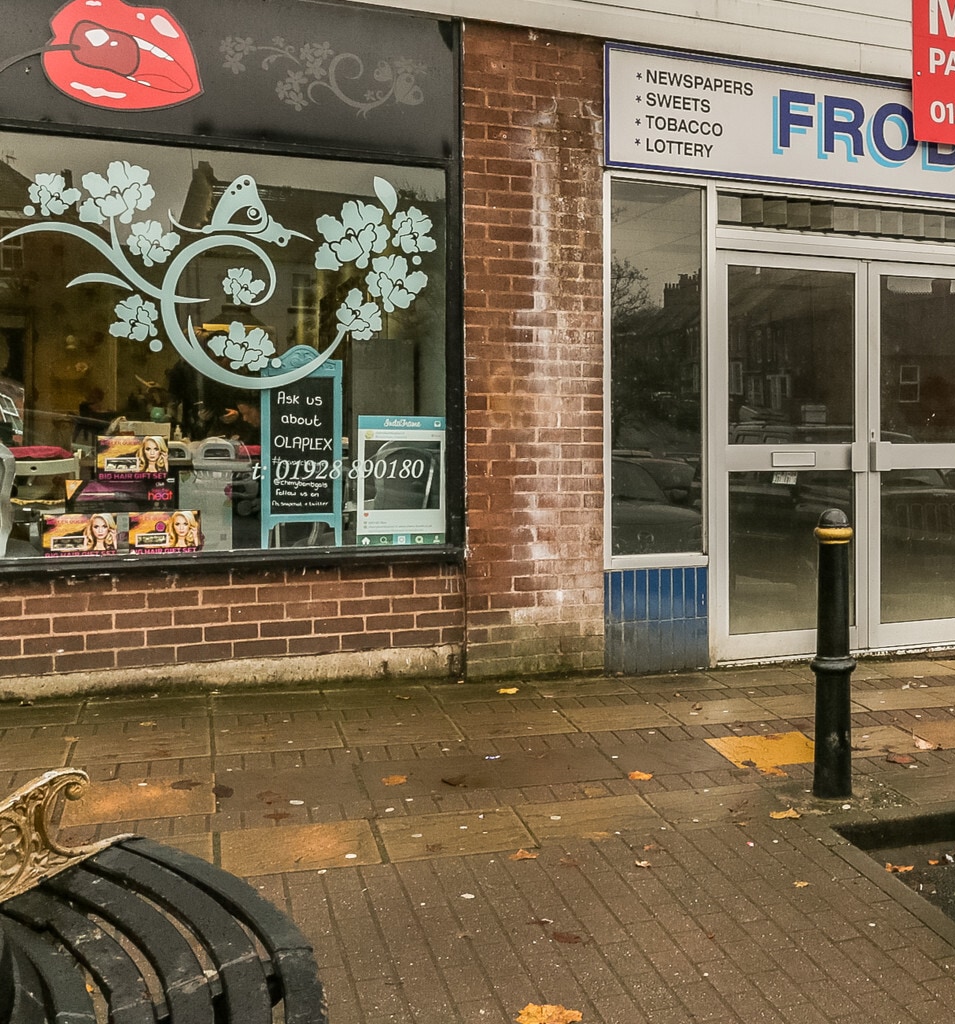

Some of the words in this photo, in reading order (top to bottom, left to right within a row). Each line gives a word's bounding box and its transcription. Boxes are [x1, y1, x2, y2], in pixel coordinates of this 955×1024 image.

[646, 69, 753, 96] NEWSPAPERS
[646, 92, 711, 113] SWEETS
[645, 114, 723, 137] TOBACCO
[646, 138, 713, 157] LOTTERY
[277, 390, 300, 405] Ask
[306, 396, 323, 406] us
[281, 414, 322, 427] about
[274, 435, 333, 452] OLAPLEX
[251, 462, 268, 481] t:
[275, 460, 342, 480] 01928
[348, 459, 425, 479] 890180
